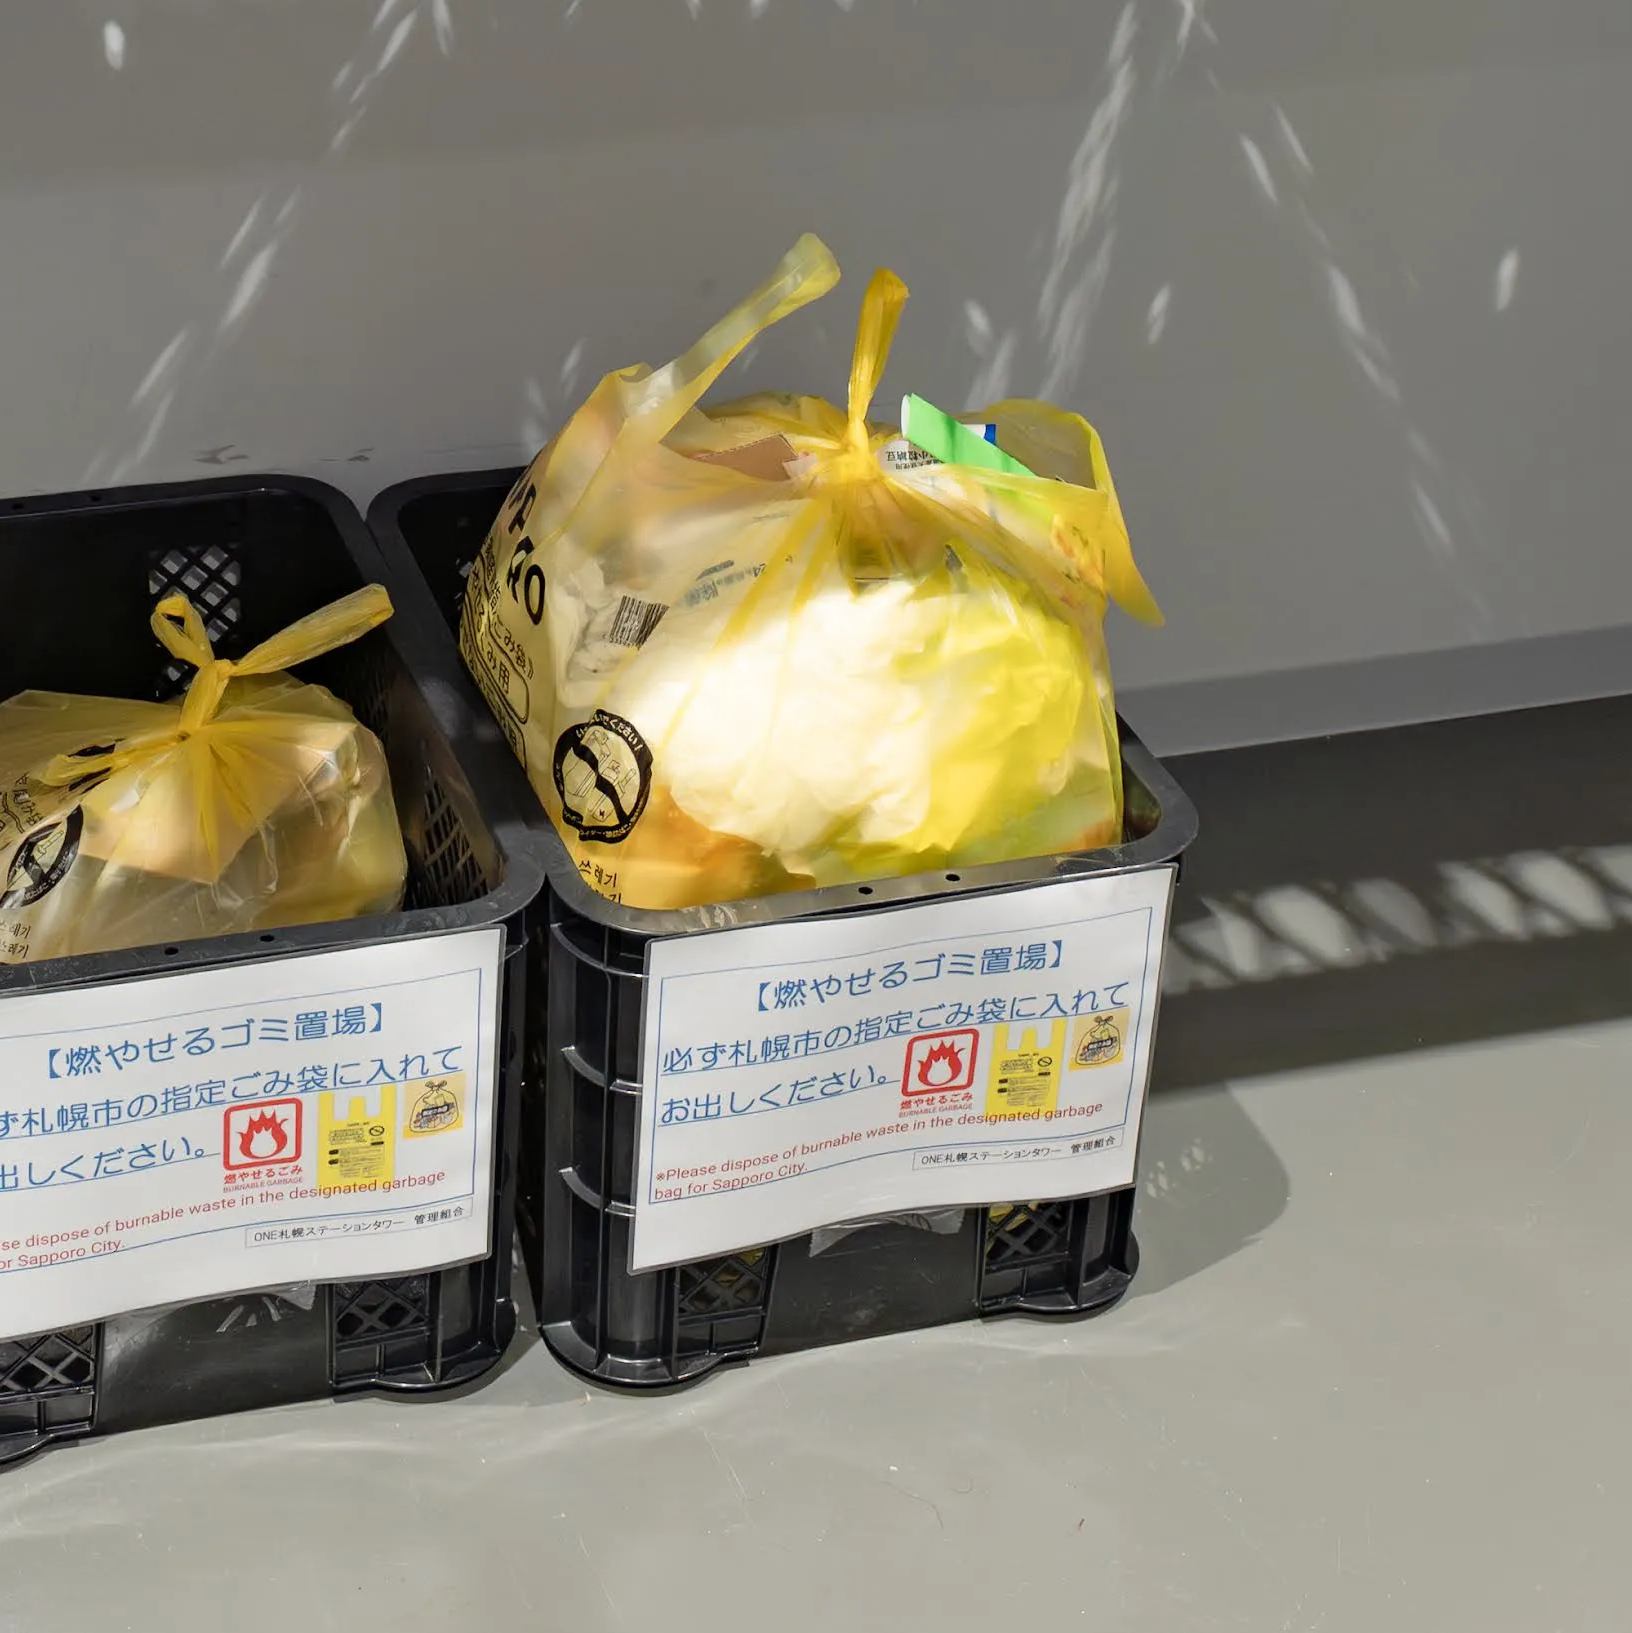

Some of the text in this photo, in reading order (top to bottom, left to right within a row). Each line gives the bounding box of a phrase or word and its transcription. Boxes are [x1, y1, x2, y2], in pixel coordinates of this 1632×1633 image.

[758, 940, 1064, 1011] 【燃やせるゴミ置場】
[49, 1002, 382, 1079] 【燃やせるゴミ置場】
[664, 982, 1129, 1072] 必ず札幌市の指定ごみ袋に入れて
[662, 1065, 888, 1124] お出しください。
[900, 1092, 973, 1110] 燃やせるごみ
[921, 1135, 1116, 1165] ONE札幌ステーションタワー 管理組合
[224, 1165, 303, 1185] 燃やせるごみ
[25, 1230, 90, 1248] dispose
[94, 1221, 111, 1236] of
[116, 1206, 184, 1232] burnable
[189, 1195, 236, 1215] waste
[241, 1194, 254, 1206] in
[260, 1188, 284, 1202] the
[289, 1179, 377, 1199] designated
[382, 1170, 445, 1193] garbage
[254, 1205, 465, 1242] ONE札幌ステーションタワー 管理組合
[17, 1246, 86, 1267] Sapporo
[91, 1239, 126, 1254] City.
